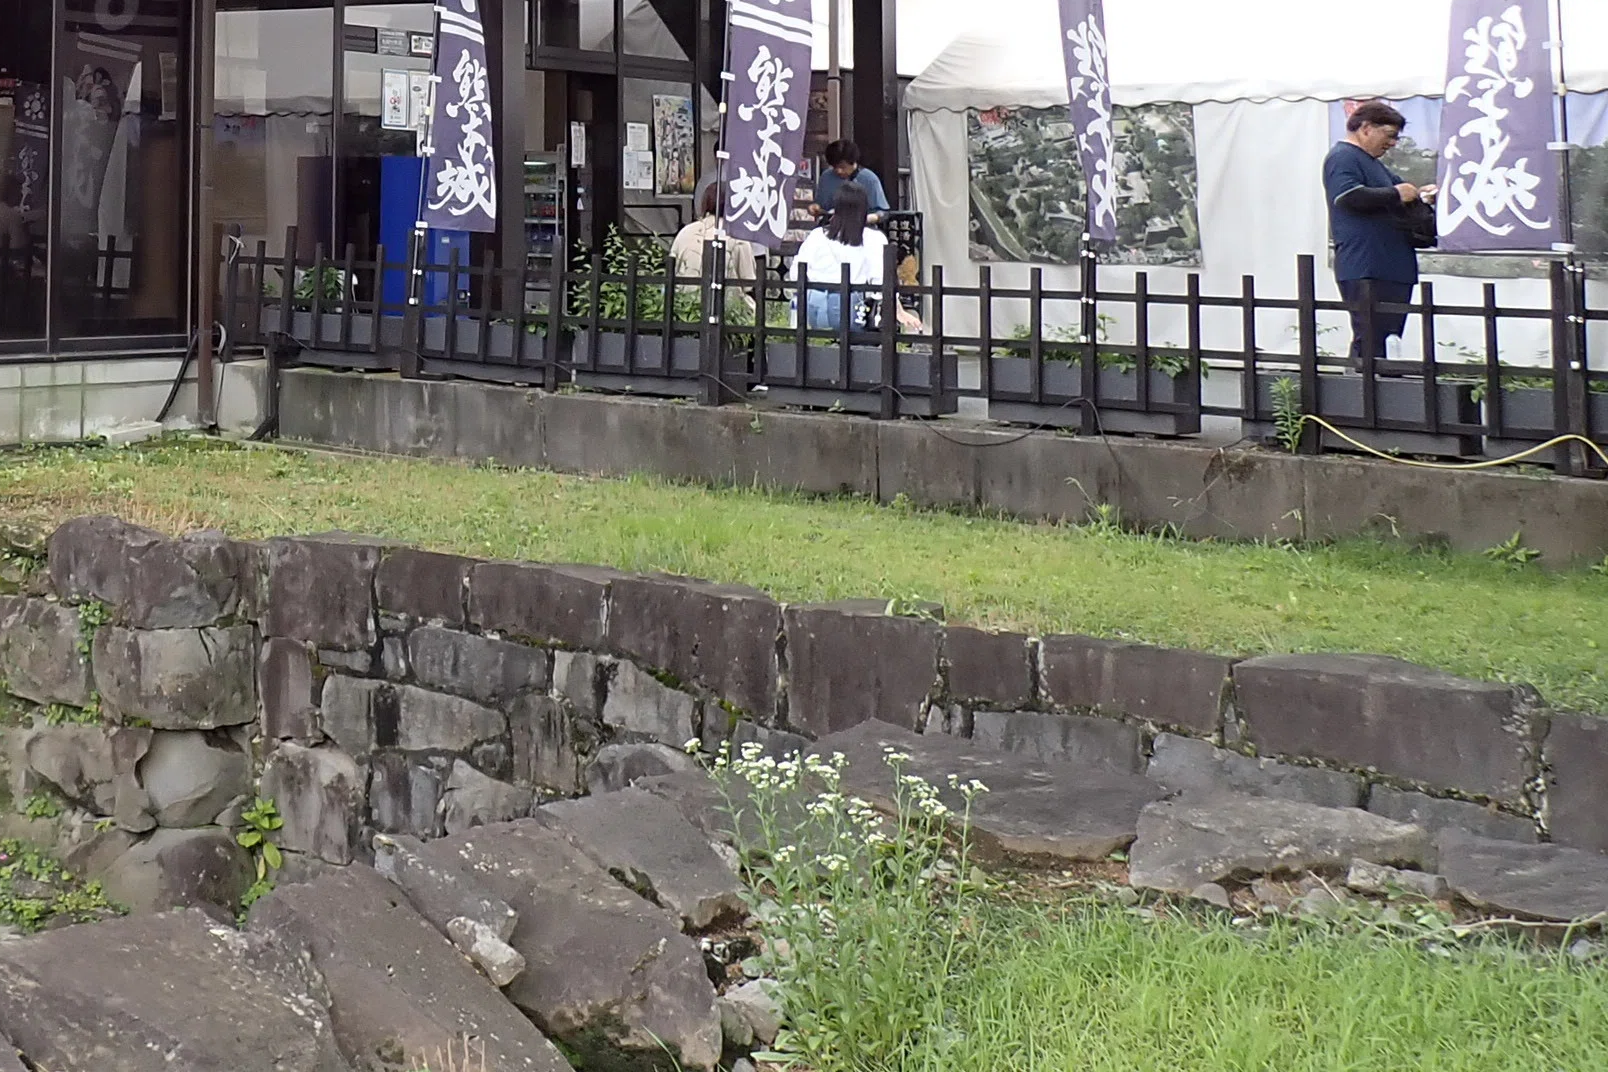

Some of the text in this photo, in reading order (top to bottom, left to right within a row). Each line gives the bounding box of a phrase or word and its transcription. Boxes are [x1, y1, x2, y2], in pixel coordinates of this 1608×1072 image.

[428, 49, 497, 219] 熊本城
[726, 45, 801, 239] 熊本城
